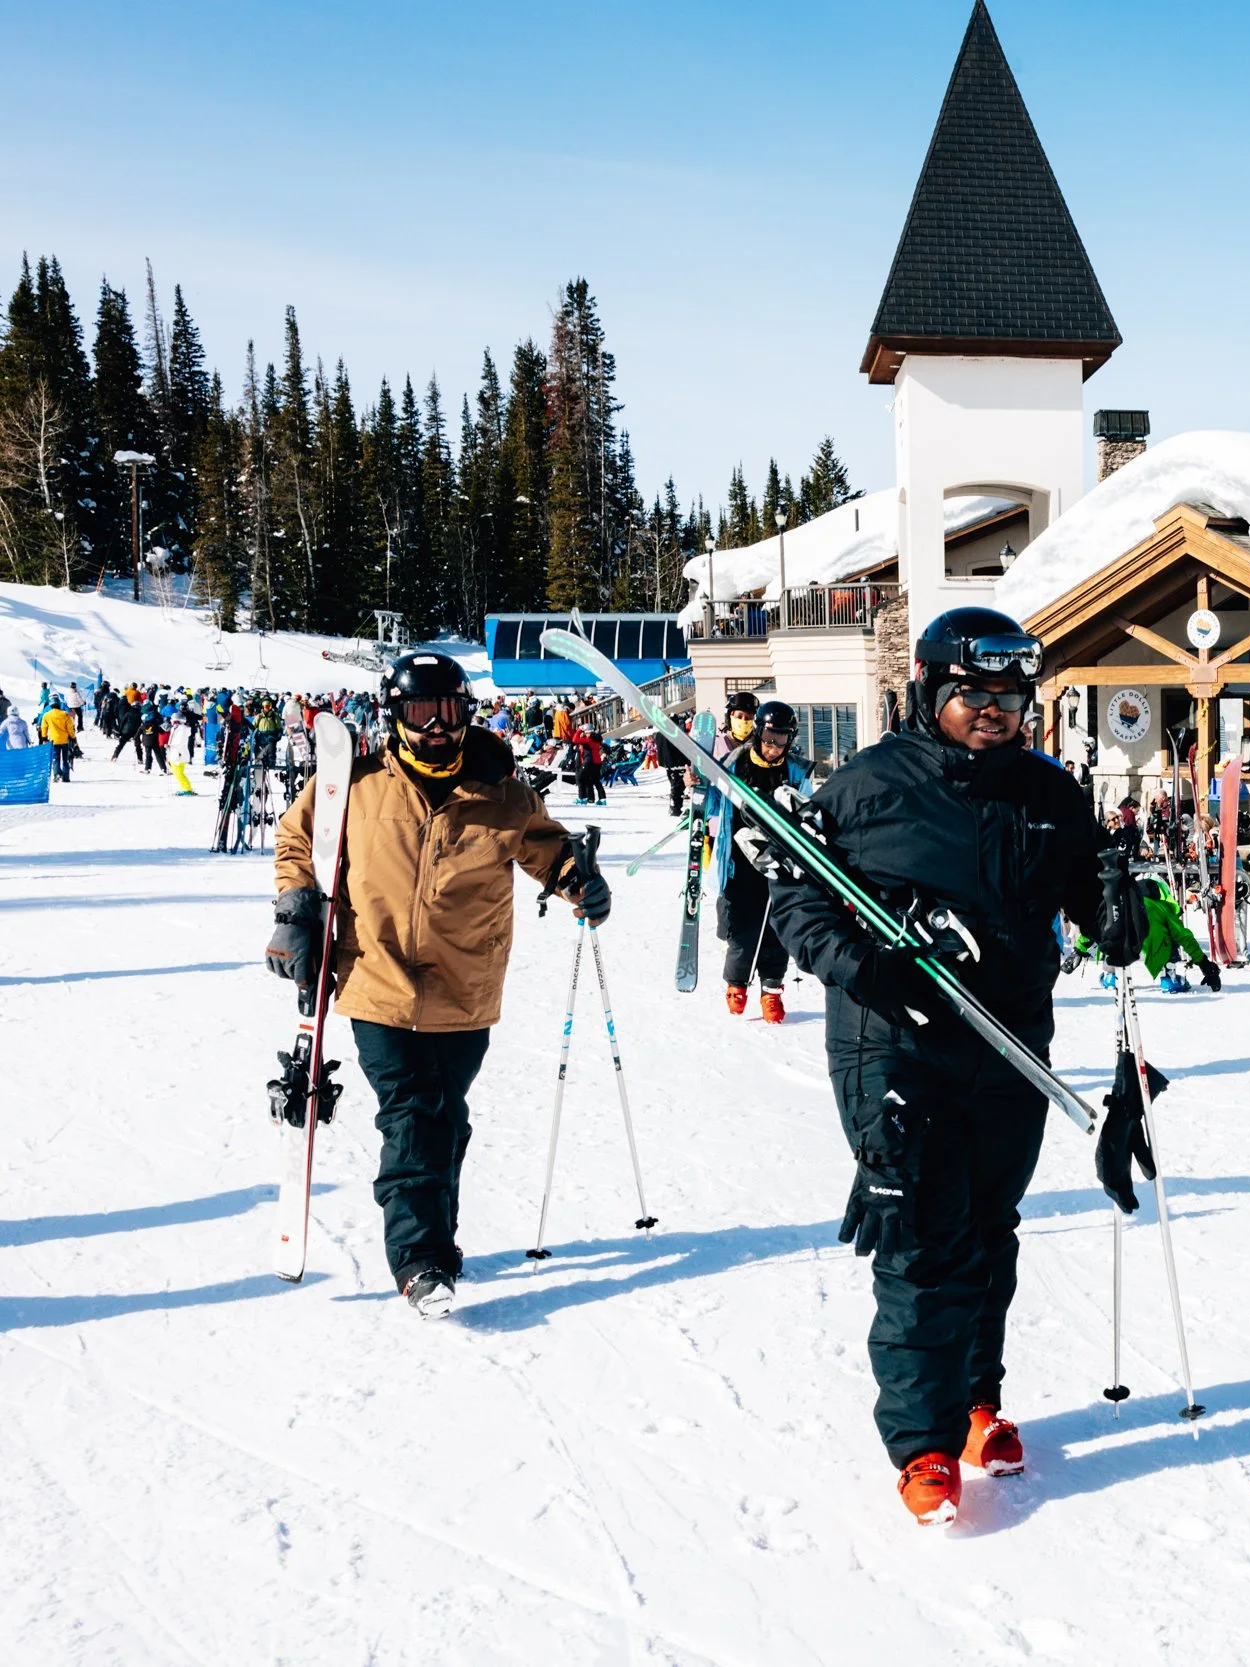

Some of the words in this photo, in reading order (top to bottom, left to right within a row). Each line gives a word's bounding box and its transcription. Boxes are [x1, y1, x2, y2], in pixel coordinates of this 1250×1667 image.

[1109, 692, 1126, 717] LITTLE
[1128, 691, 1149, 715] DOLLIE
[1114, 728, 1146, 740] WAFFLES
